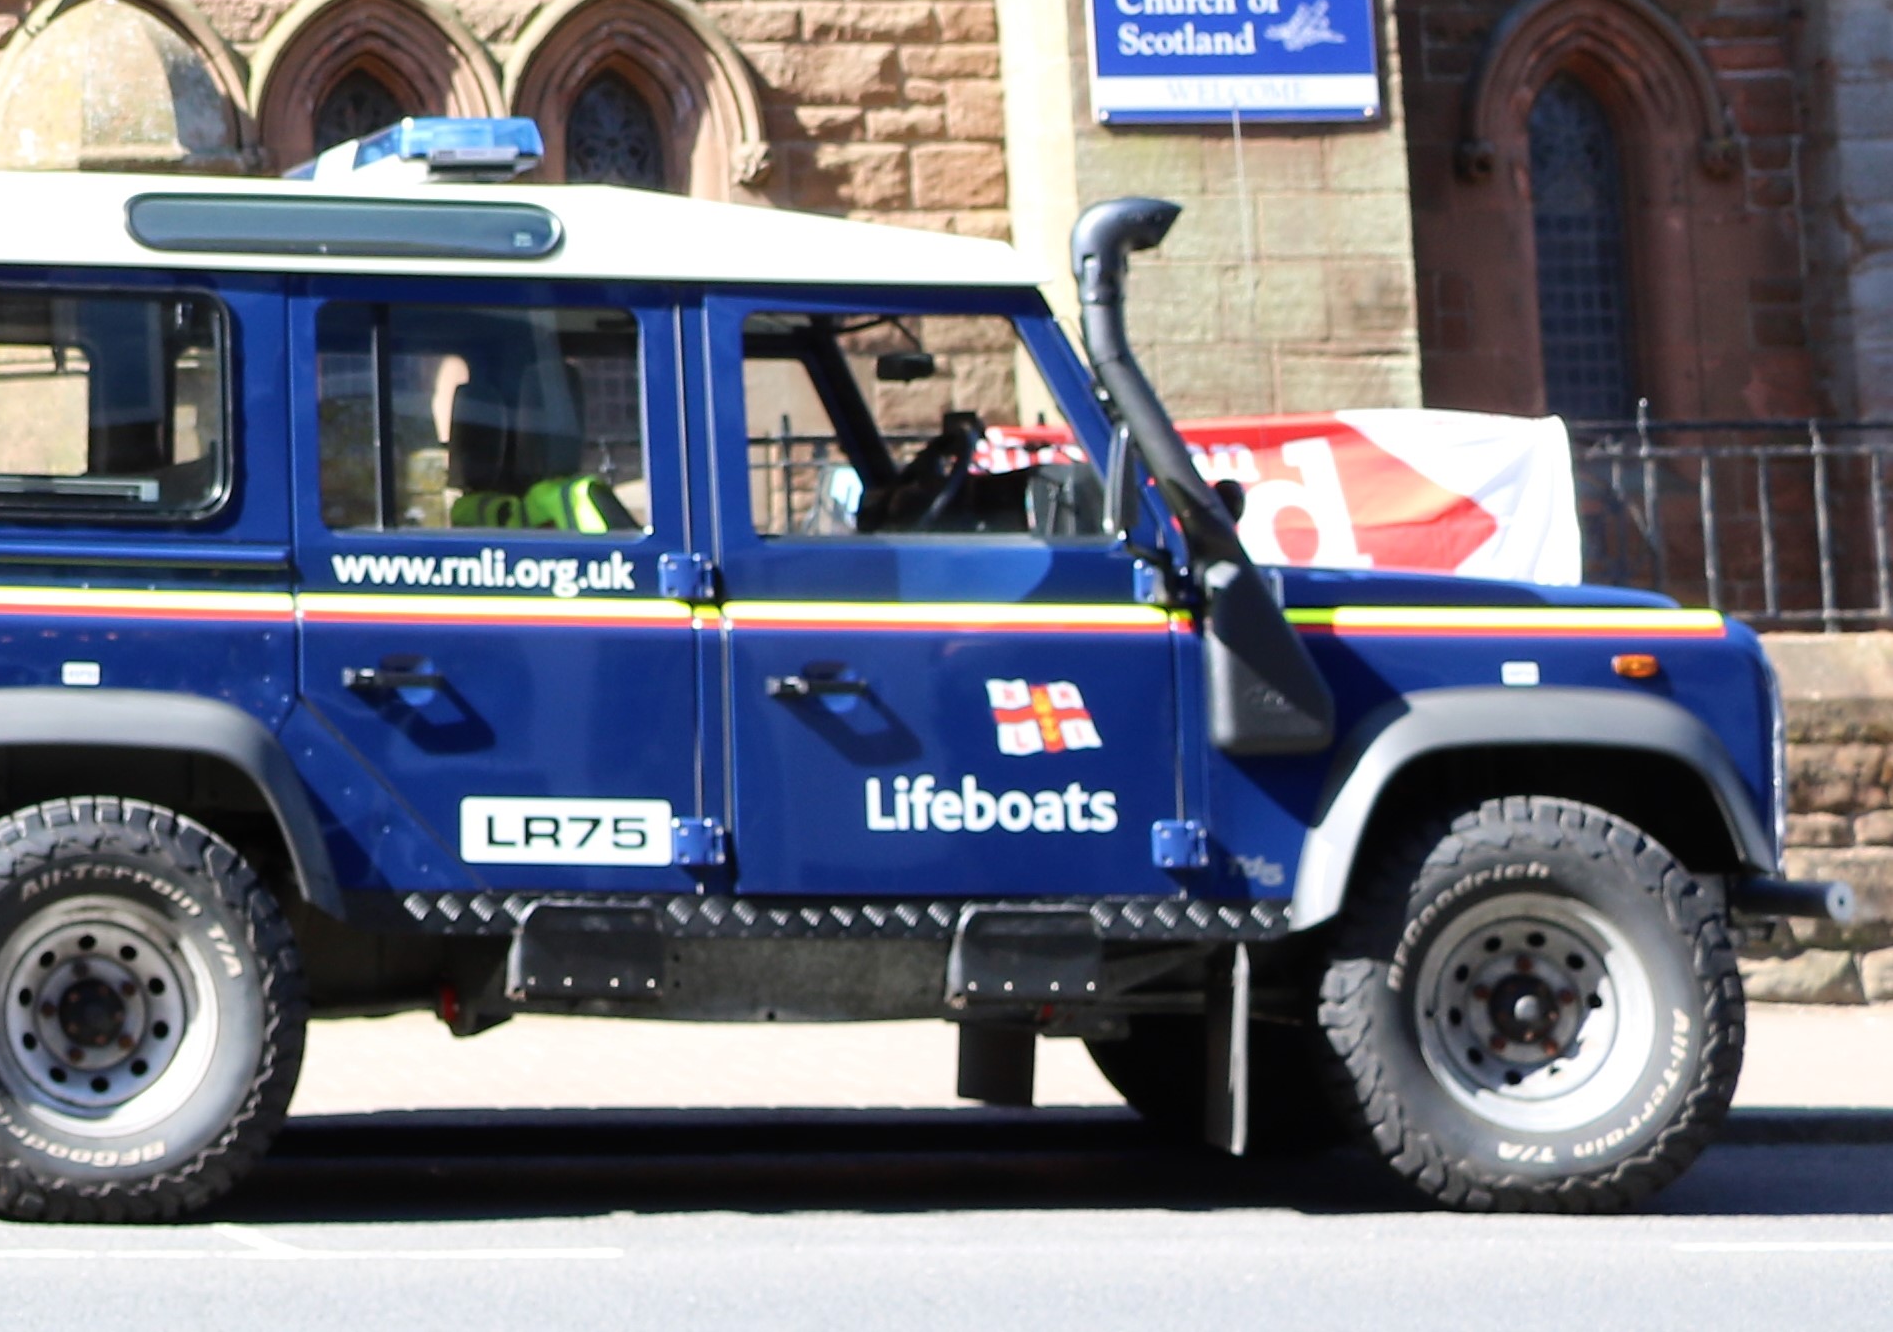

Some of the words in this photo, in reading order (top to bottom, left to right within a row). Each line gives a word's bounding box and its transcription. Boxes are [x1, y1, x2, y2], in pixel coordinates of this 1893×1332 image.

[1117, 20, 1257, 56] Scotland
[1167, 80, 1306, 104] WELCOME
[331, 547, 635, 598] www.rnli.org.uk
[866, 775, 1118, 833] Lifeboats
[486, 815, 649, 849] LR75
[21, 863, 203, 917] All-Terrain
